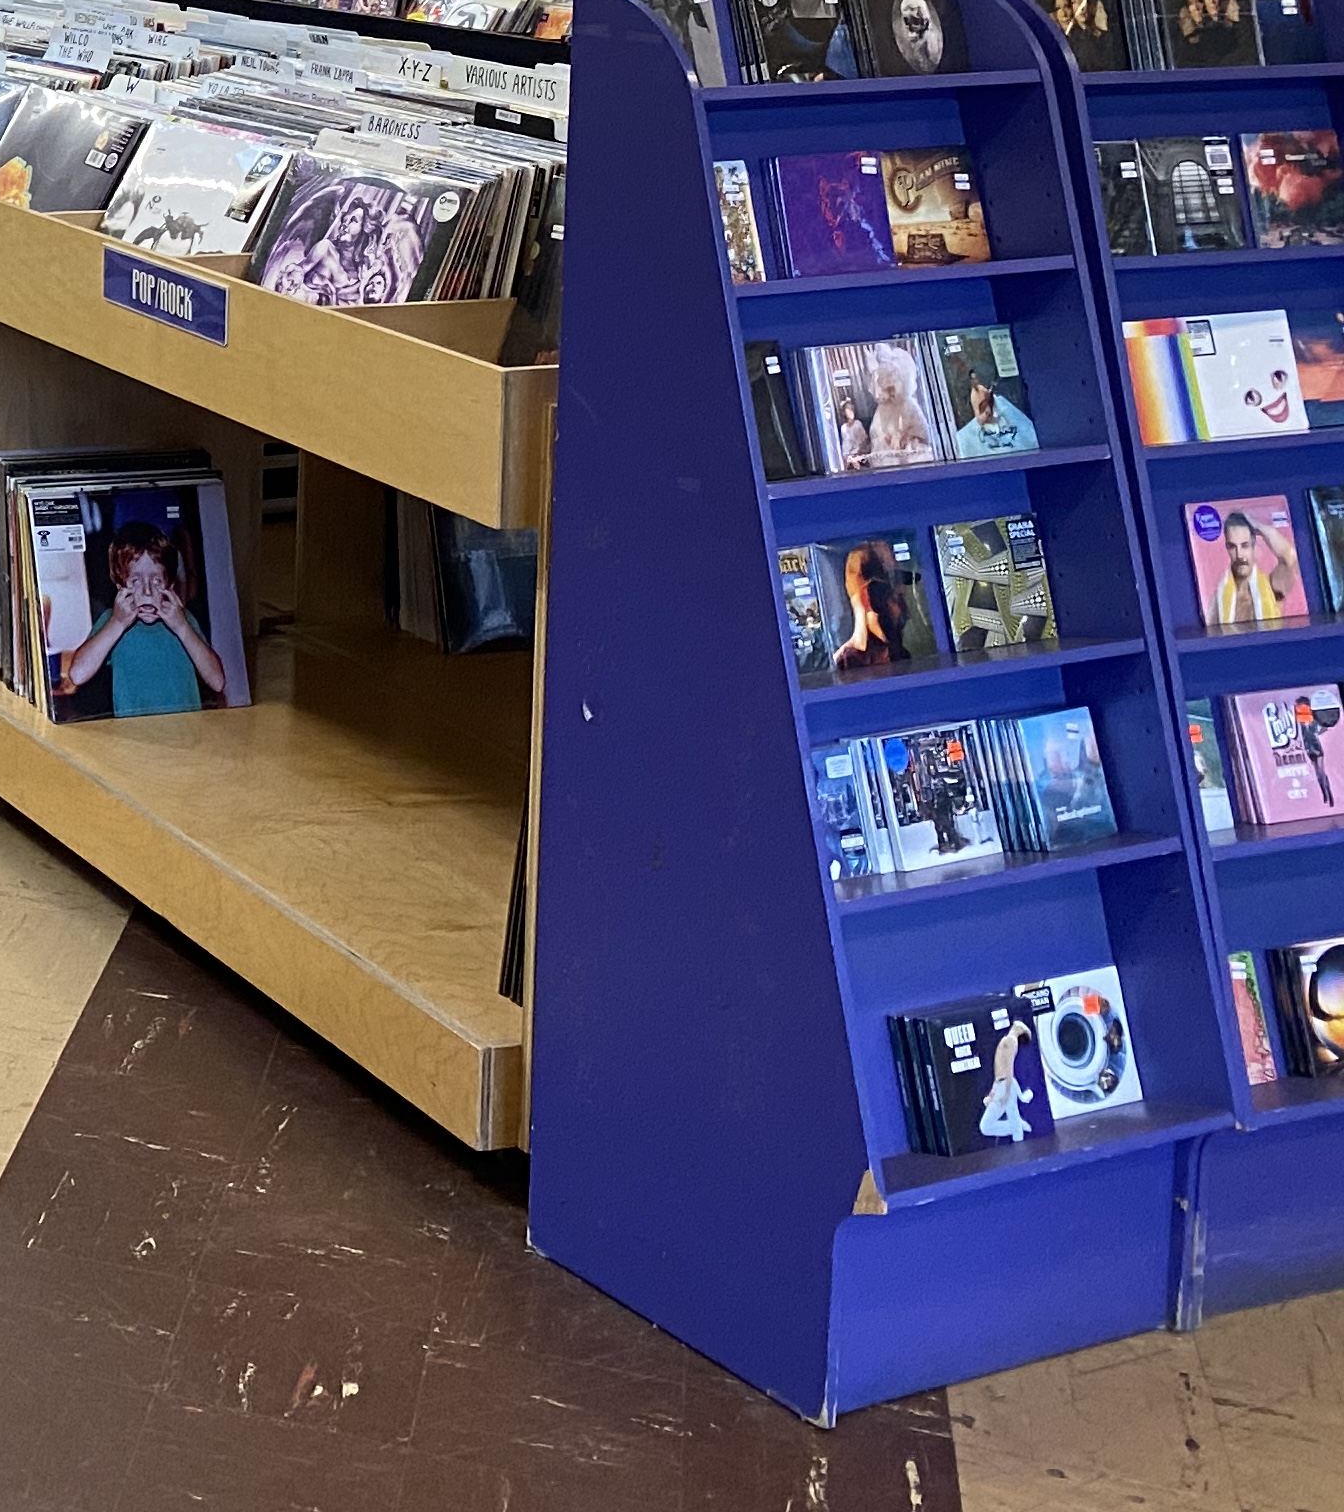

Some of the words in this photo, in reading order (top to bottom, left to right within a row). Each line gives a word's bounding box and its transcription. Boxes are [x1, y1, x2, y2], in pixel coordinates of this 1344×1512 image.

[64, 31, 89, 46] WILCO
[148, 34, 168, 47] WIRE
[59, 44, 72, 59] THE
[241, 55, 257, 70] NEIL
[310, 62, 331, 78] FRANK
[333, 66, 354, 84] ZAPPA
[398, 56, 432, 83] X-Y-Z
[125, 77, 140, 95] W
[466, 64, 507, 90] VARIOUS
[512, 74, 557, 101] ARTISTS
[367, 116, 420, 140] BARONESS
[131, 268, 193, 322] POP/ROCK
[943, 1022, 976, 1049] QUEEN
